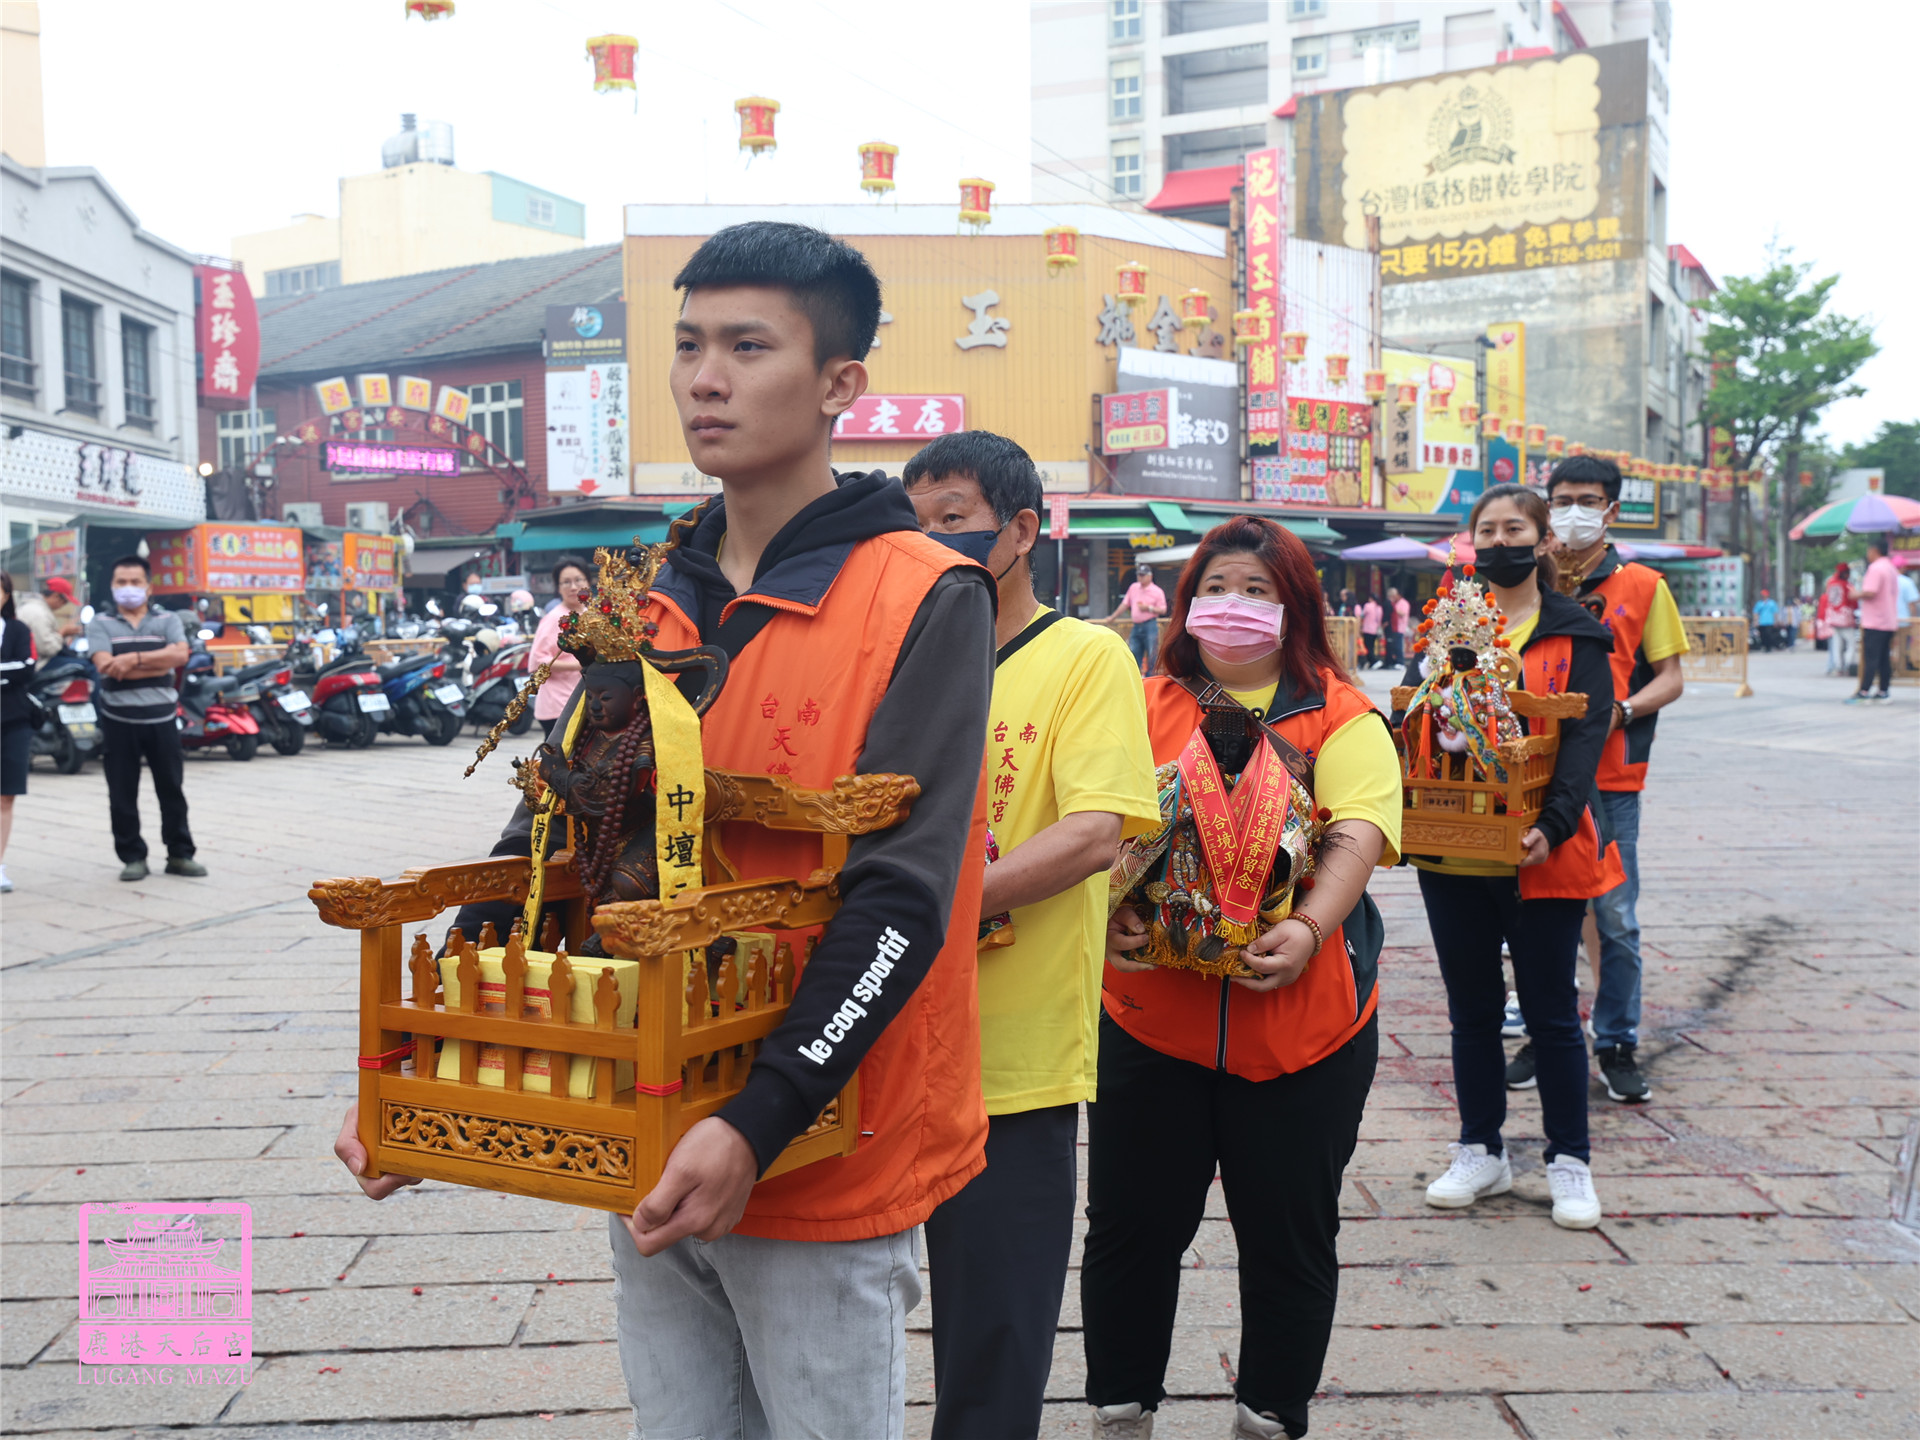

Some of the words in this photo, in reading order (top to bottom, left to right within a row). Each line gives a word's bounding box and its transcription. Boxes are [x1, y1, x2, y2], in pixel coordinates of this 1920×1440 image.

[1360, 162, 1587, 217] 台灣優格餅乾學院
[954, 289, 1012, 351] 玉
[993, 720, 1038, 745] 台南
[991, 747, 1020, 824] 天佛宮
[1235, 745, 1284, 891] 教總廟三清宮進香留念
[797, 1038, 833, 1066] le
[822, 998, 868, 1044] coq
[852, 926, 910, 1003] sportif
